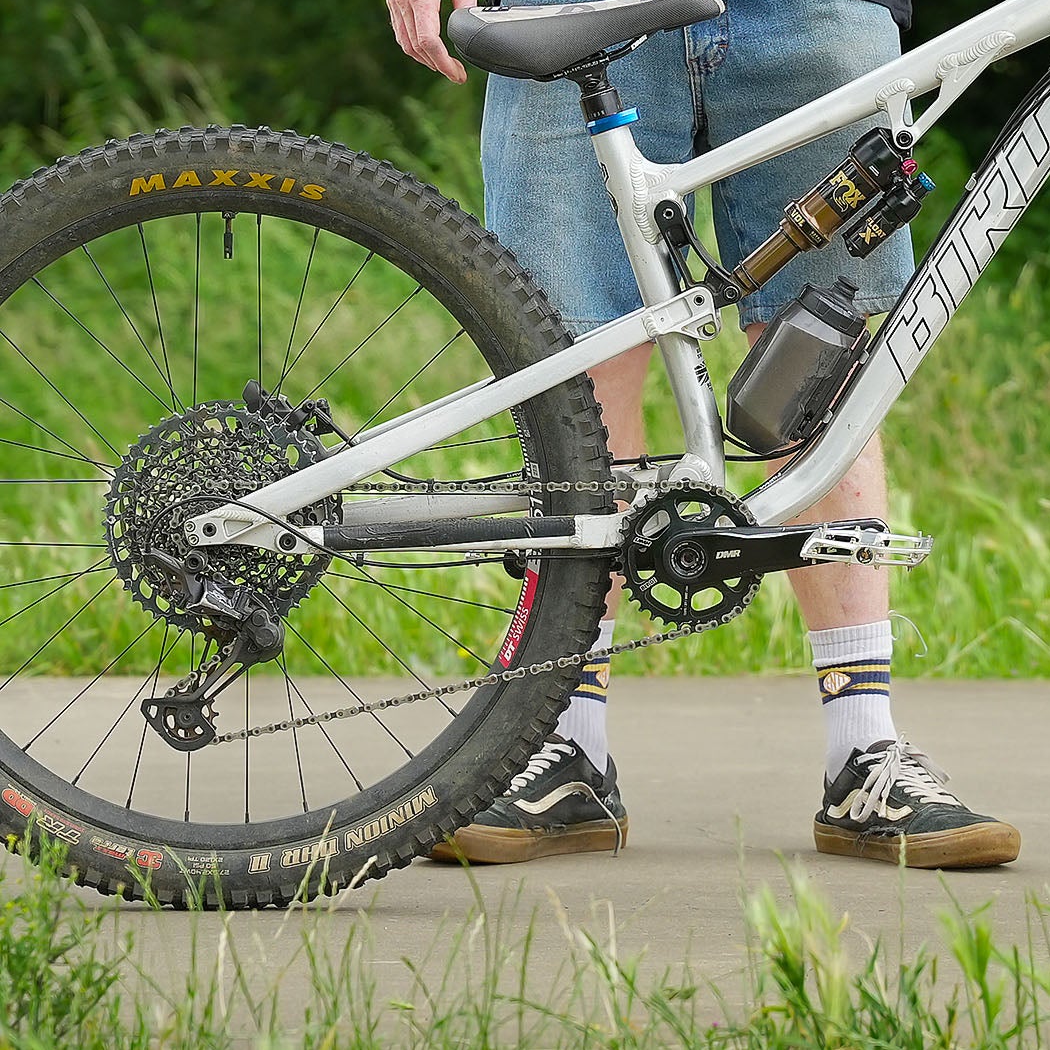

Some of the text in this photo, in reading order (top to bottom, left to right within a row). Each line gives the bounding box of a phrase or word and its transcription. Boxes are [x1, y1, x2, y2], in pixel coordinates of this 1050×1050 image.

[129, 169, 327, 200] MAXXIS
[829, 170, 867, 210] FOX
[859, 226, 878, 245] X
[865, 216, 887, 239] FLOAT
[715, 549, 741, 560] DMR
[503, 640, 516, 662] DT
[512, 607, 529, 640] SWISS
[1, 788, 36, 818] DD
[36, 814, 82, 845] TR
[248, 784, 439, 875] MINION DHR II
[136, 848, 164, 870] 3C
